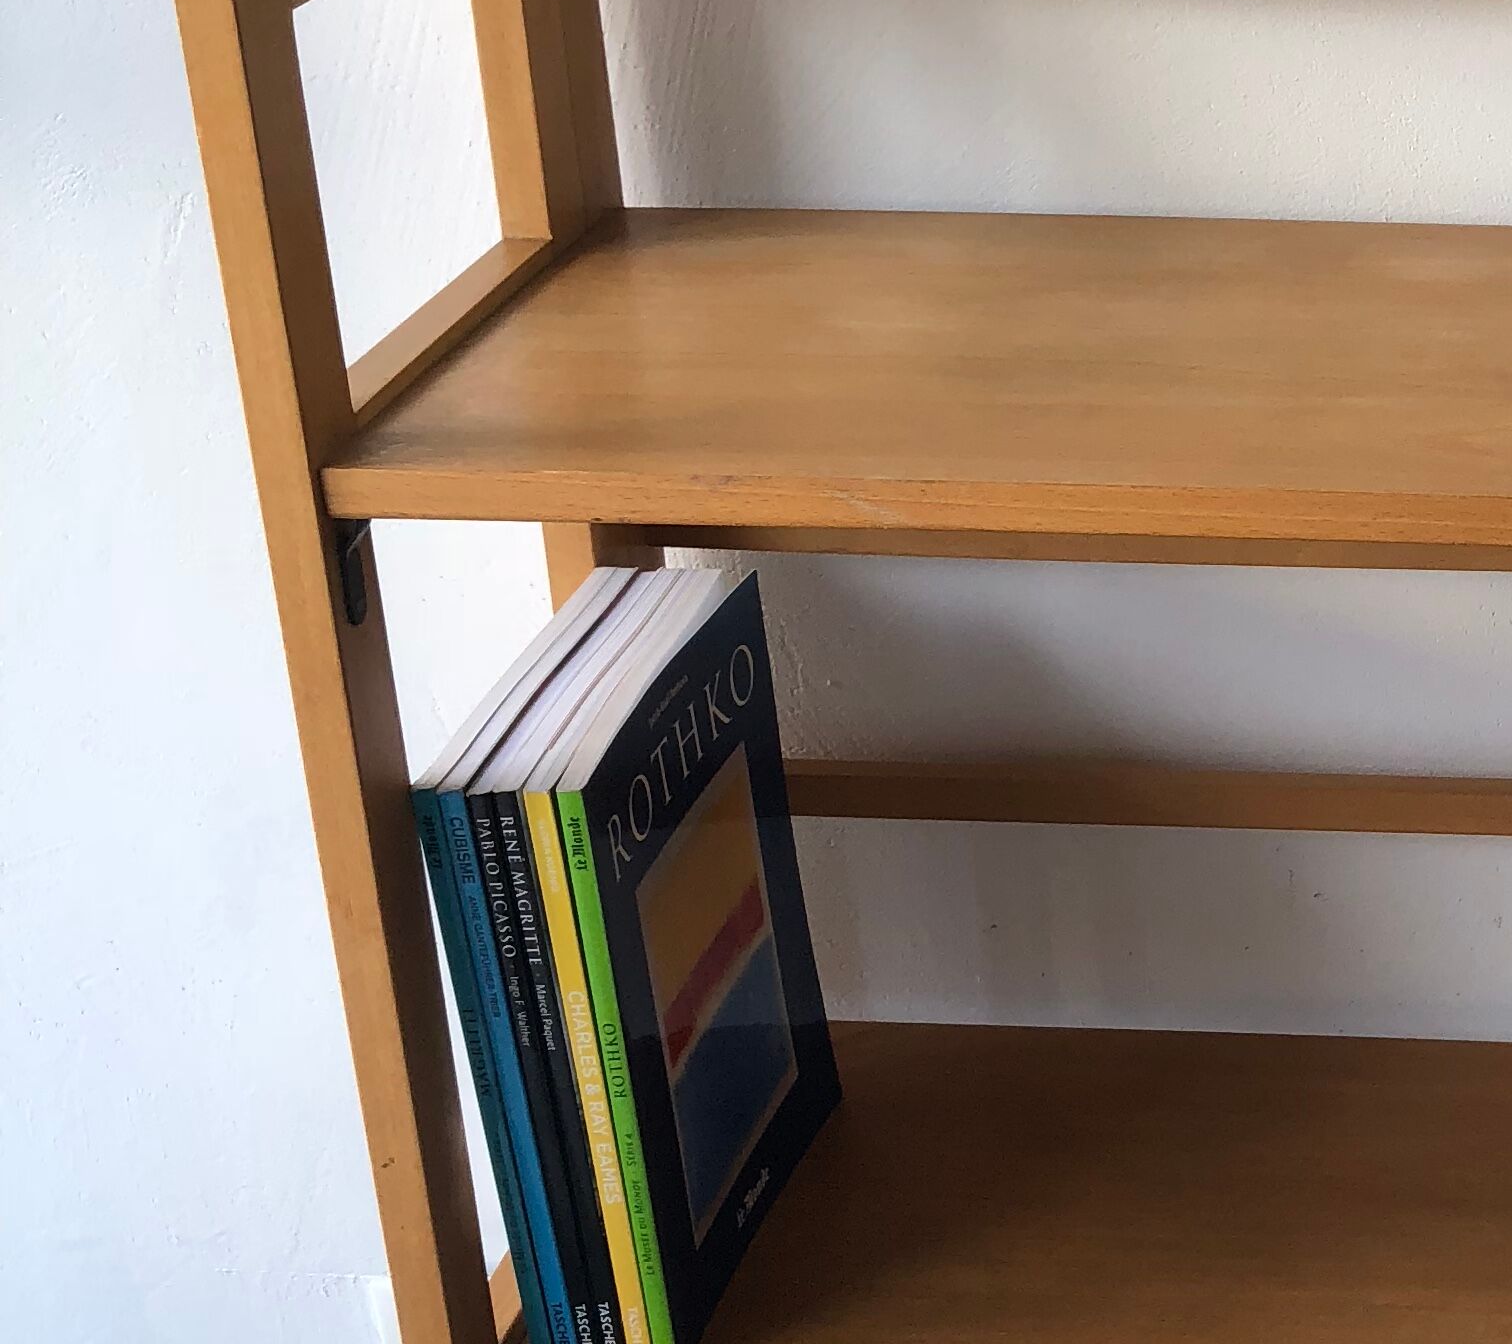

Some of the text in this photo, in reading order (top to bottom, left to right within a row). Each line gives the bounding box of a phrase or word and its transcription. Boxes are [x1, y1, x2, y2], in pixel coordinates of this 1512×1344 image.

[608, 644, 754, 882] ROTHKO
[450, 817, 476, 884] CUBISME
[568, 815, 588, 871] Le Monde
[477, 818, 516, 957] PABLO PICASSO
[500, 816, 541, 965] RENÉ MAGRITTE
[509, 976, 521, 998] Ingo
[516, 1010, 531, 1047] Walther
[535, 984, 556, 1050] Marcel Paquet
[567, 990, 623, 1205] CHARLES & RAY EAMES
[603, 1023, 628, 1098] ROTHKO
